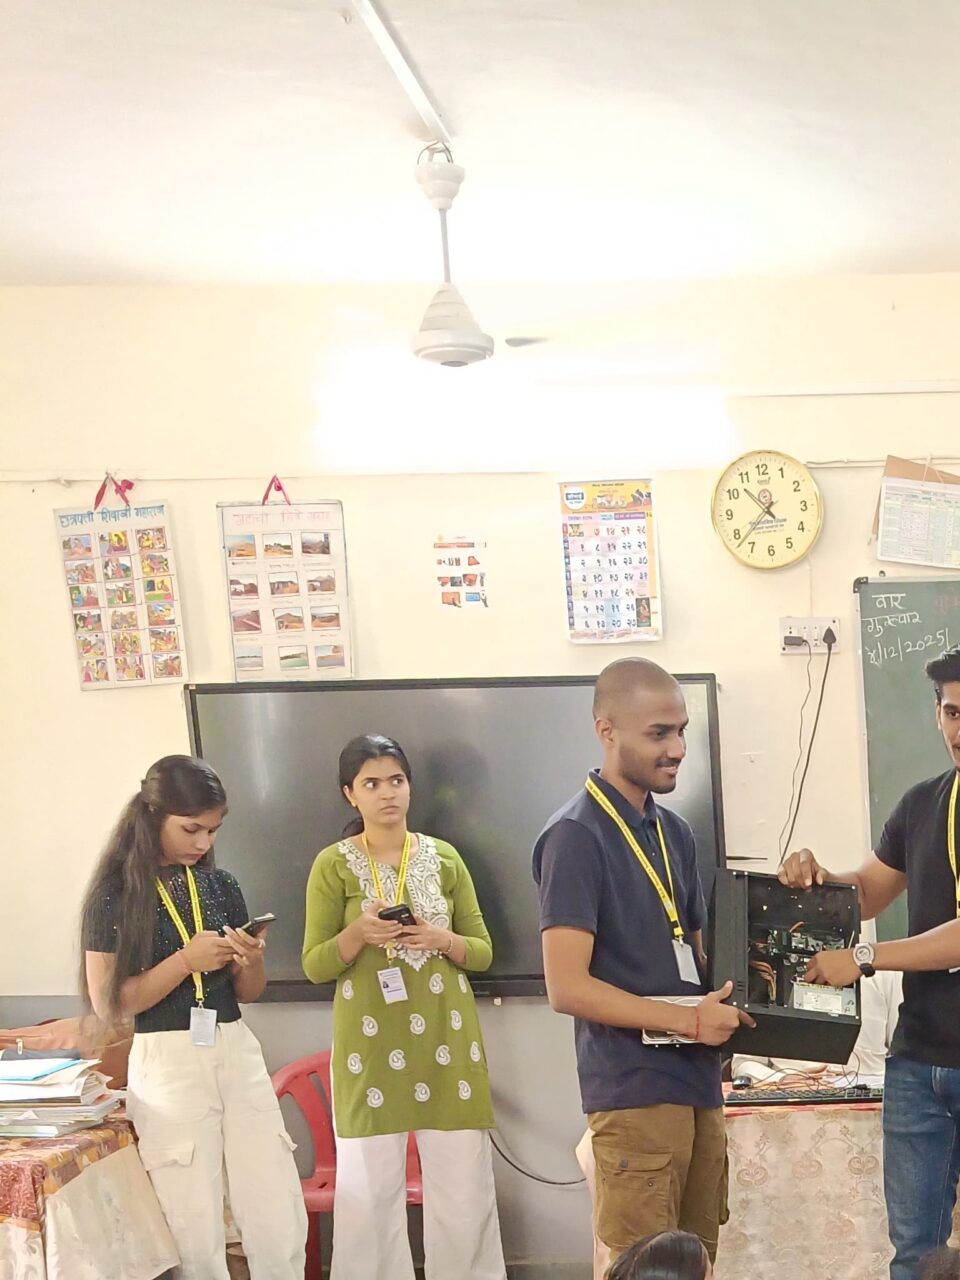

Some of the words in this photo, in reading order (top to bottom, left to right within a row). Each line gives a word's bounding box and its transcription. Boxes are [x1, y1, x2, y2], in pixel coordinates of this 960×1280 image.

[755, 463, 769, 476] 12
[778, 466, 785, 479] 1
[738, 471, 750, 484] 11
[792, 480, 801, 492] 2
[726, 488, 740, 500] 10
[800, 500, 808, 512] 3
[725, 509, 733, 520] 9
[797, 521, 805, 532] 4
[733, 528, 741, 540] 8
[748, 541, 755, 554] 7
[785, 537, 793, 549] 5
[767, 545, 775, 556] 6
[872, 593, 906, 609] वार
